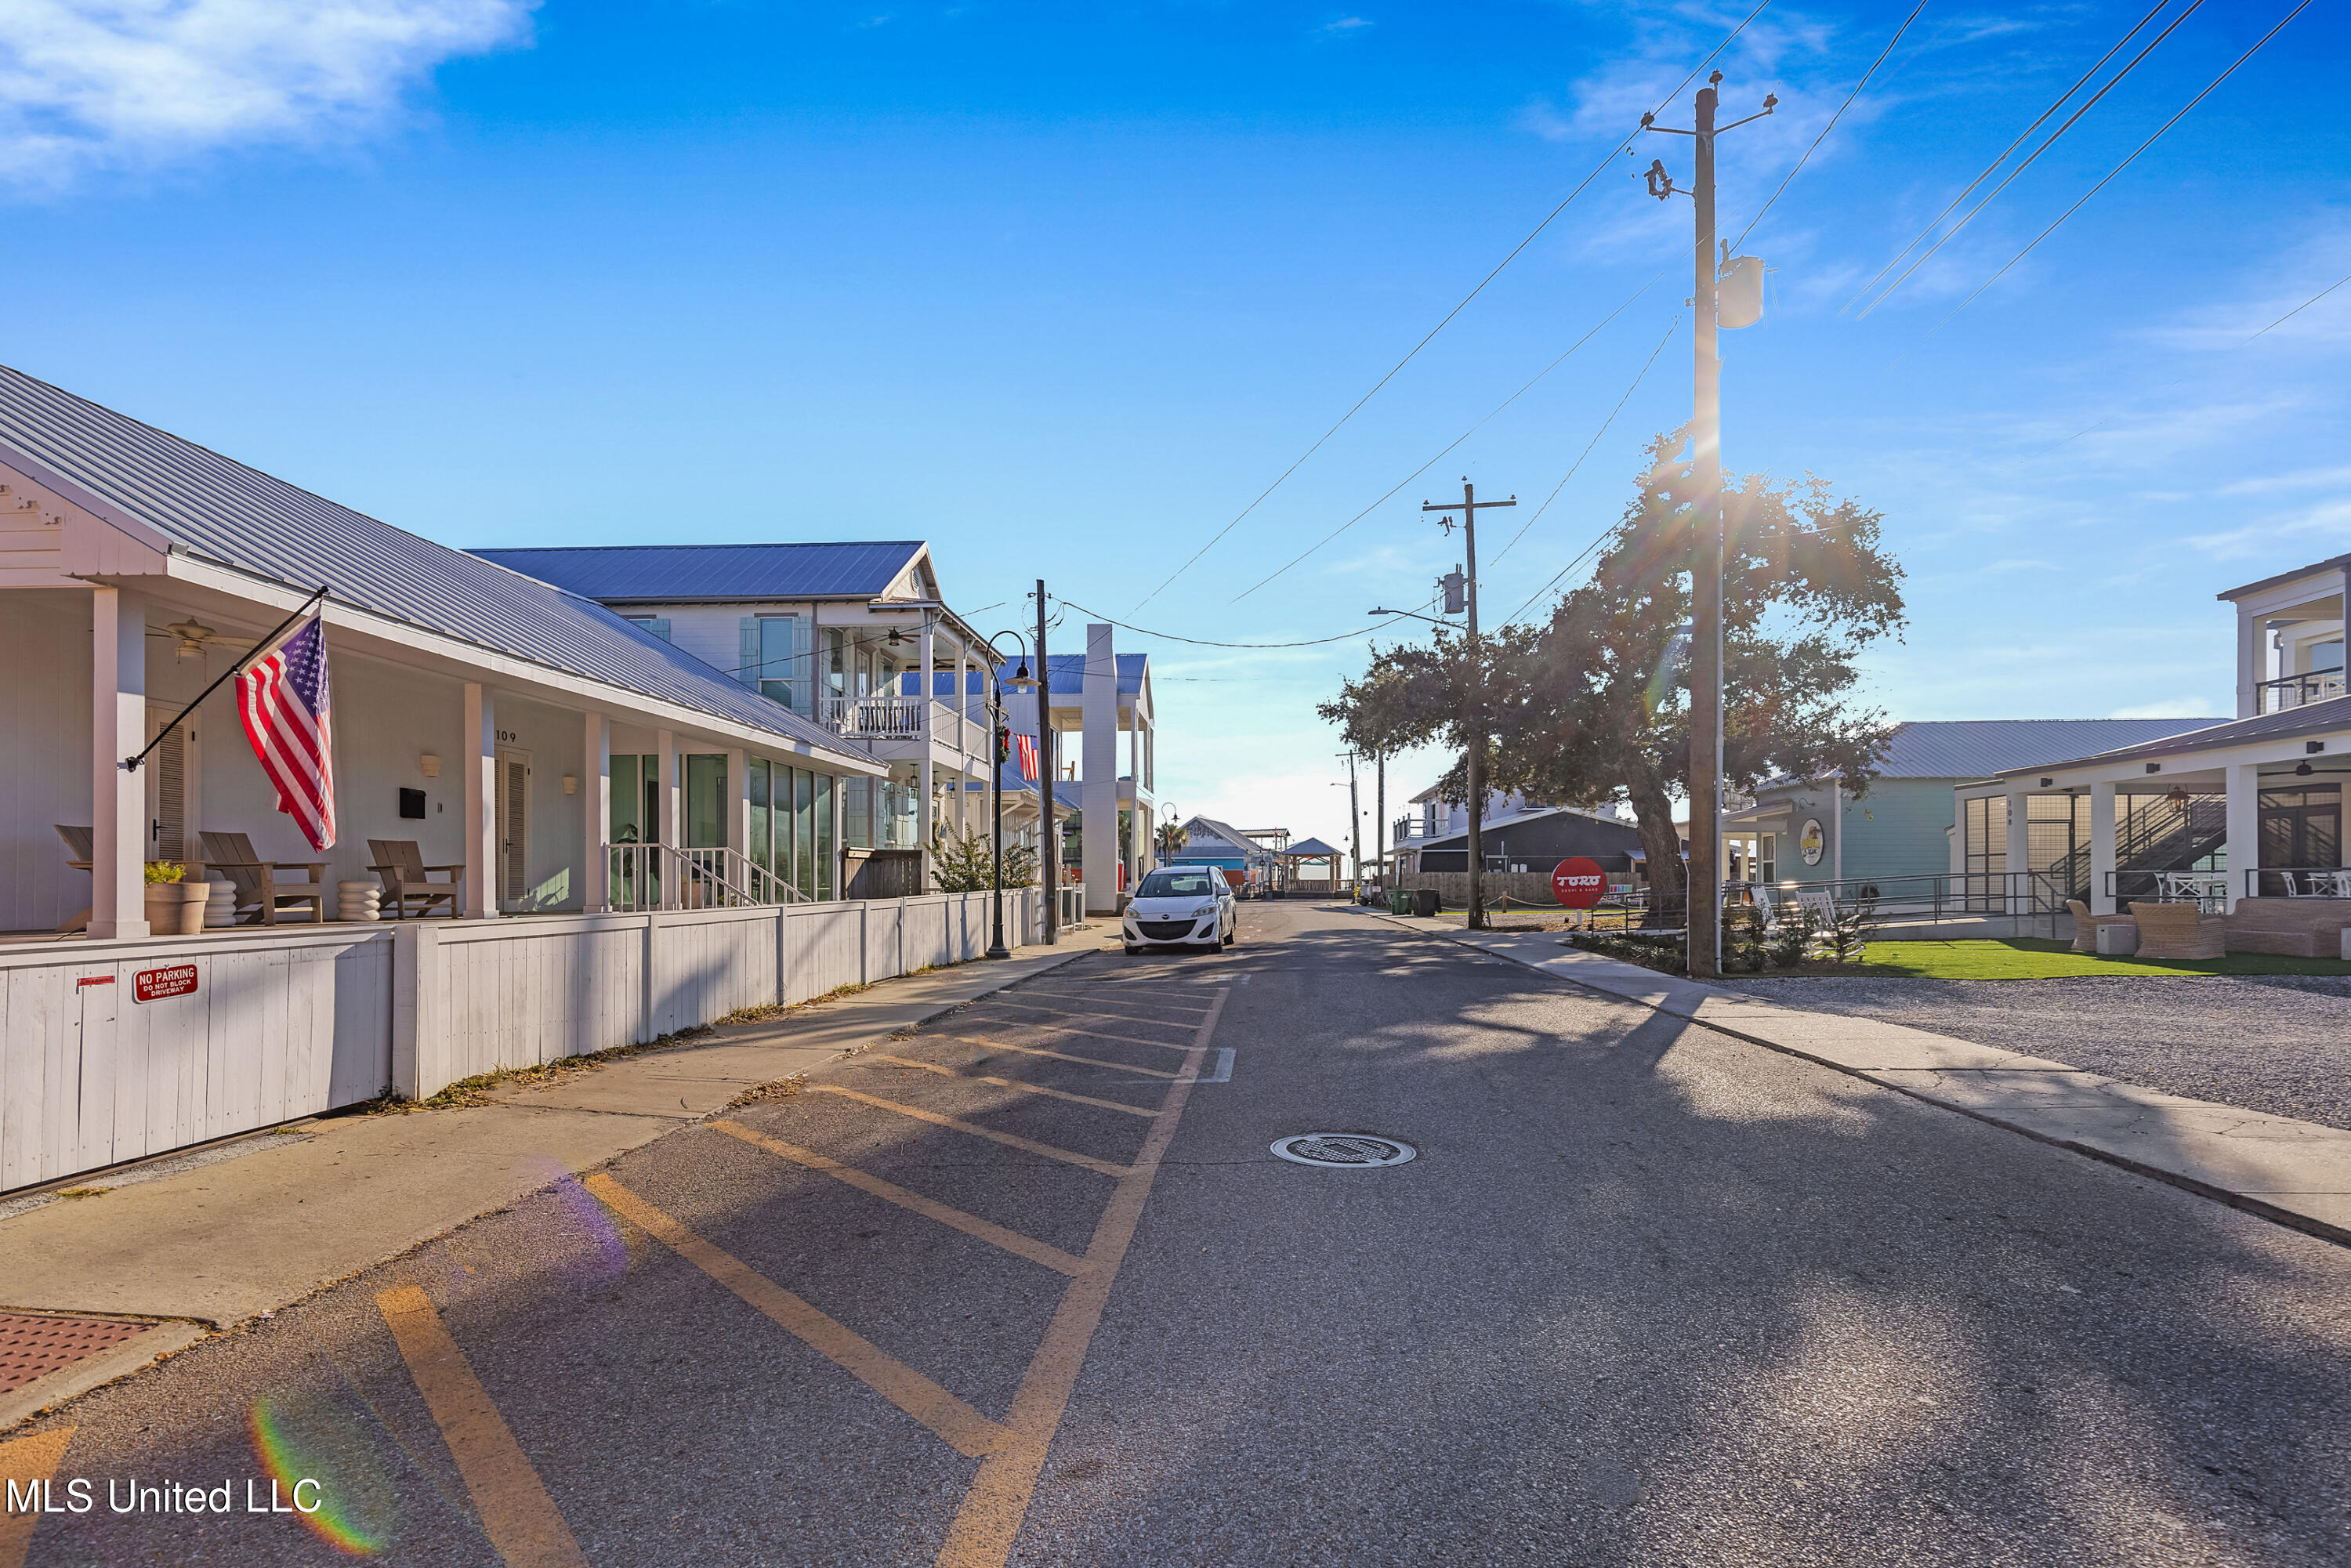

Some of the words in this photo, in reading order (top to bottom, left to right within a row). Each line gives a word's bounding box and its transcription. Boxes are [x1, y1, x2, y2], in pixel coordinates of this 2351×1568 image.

[496, 730, 516, 742] 109
[1556, 875, 1601, 886] TORO
[139, 973, 152, 985] NO
[156, 968, 194, 983] PARKING
[170, 979, 191, 987] BLOCK
[151, 986, 185, 997] DRIVEWAY
